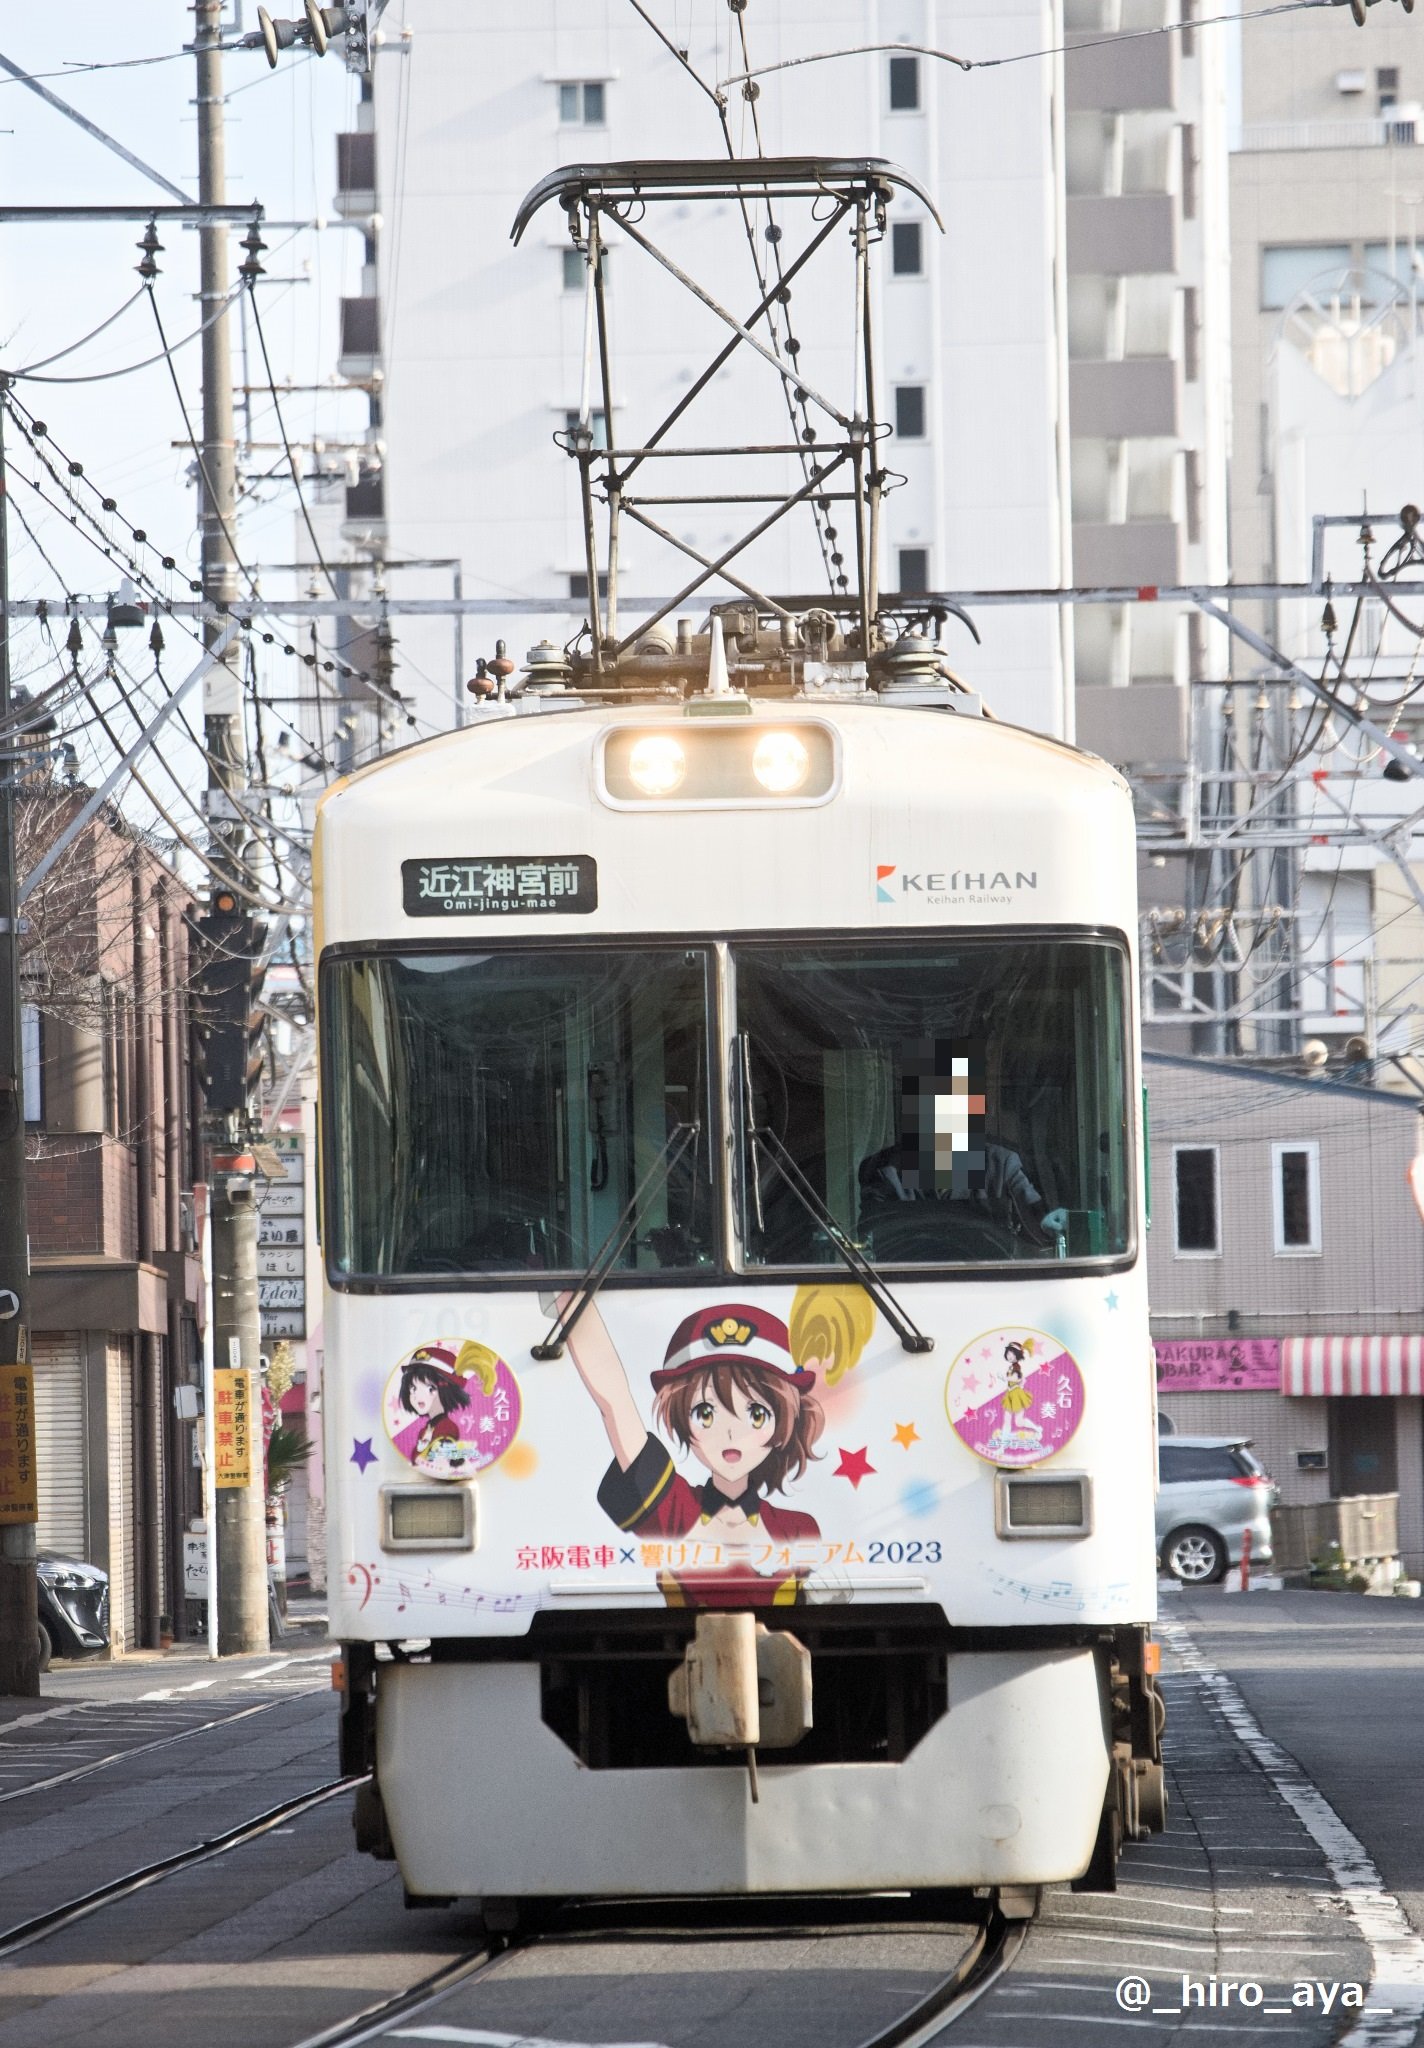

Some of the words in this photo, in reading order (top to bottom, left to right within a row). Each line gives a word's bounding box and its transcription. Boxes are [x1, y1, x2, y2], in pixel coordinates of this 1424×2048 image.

[418, 863, 580, 898] 近江神宮前
[902, 870, 1037, 892] KEIHAN
[443, 898, 557, 911] Omi-jingu-mae
[927, 895, 965, 905] Keihan
[969, 894, 1012, 905] Railway
[266, 1262, 295, 1272] ほし
[260, 1285, 298, 1300] Eden
[1057, 1376, 1072, 1408] 久石
[494, 1389, 509, 1421] 久石
[1041, 1402, 1056, 1418] 奏
[234, 1378, 245, 1457] 電車が通ります
[479, 1417, 494, 1433] 奏
[14, 1377, 30, 1484] 電車が通ります
[217, 1391, 234, 1467] 駐車禁止
